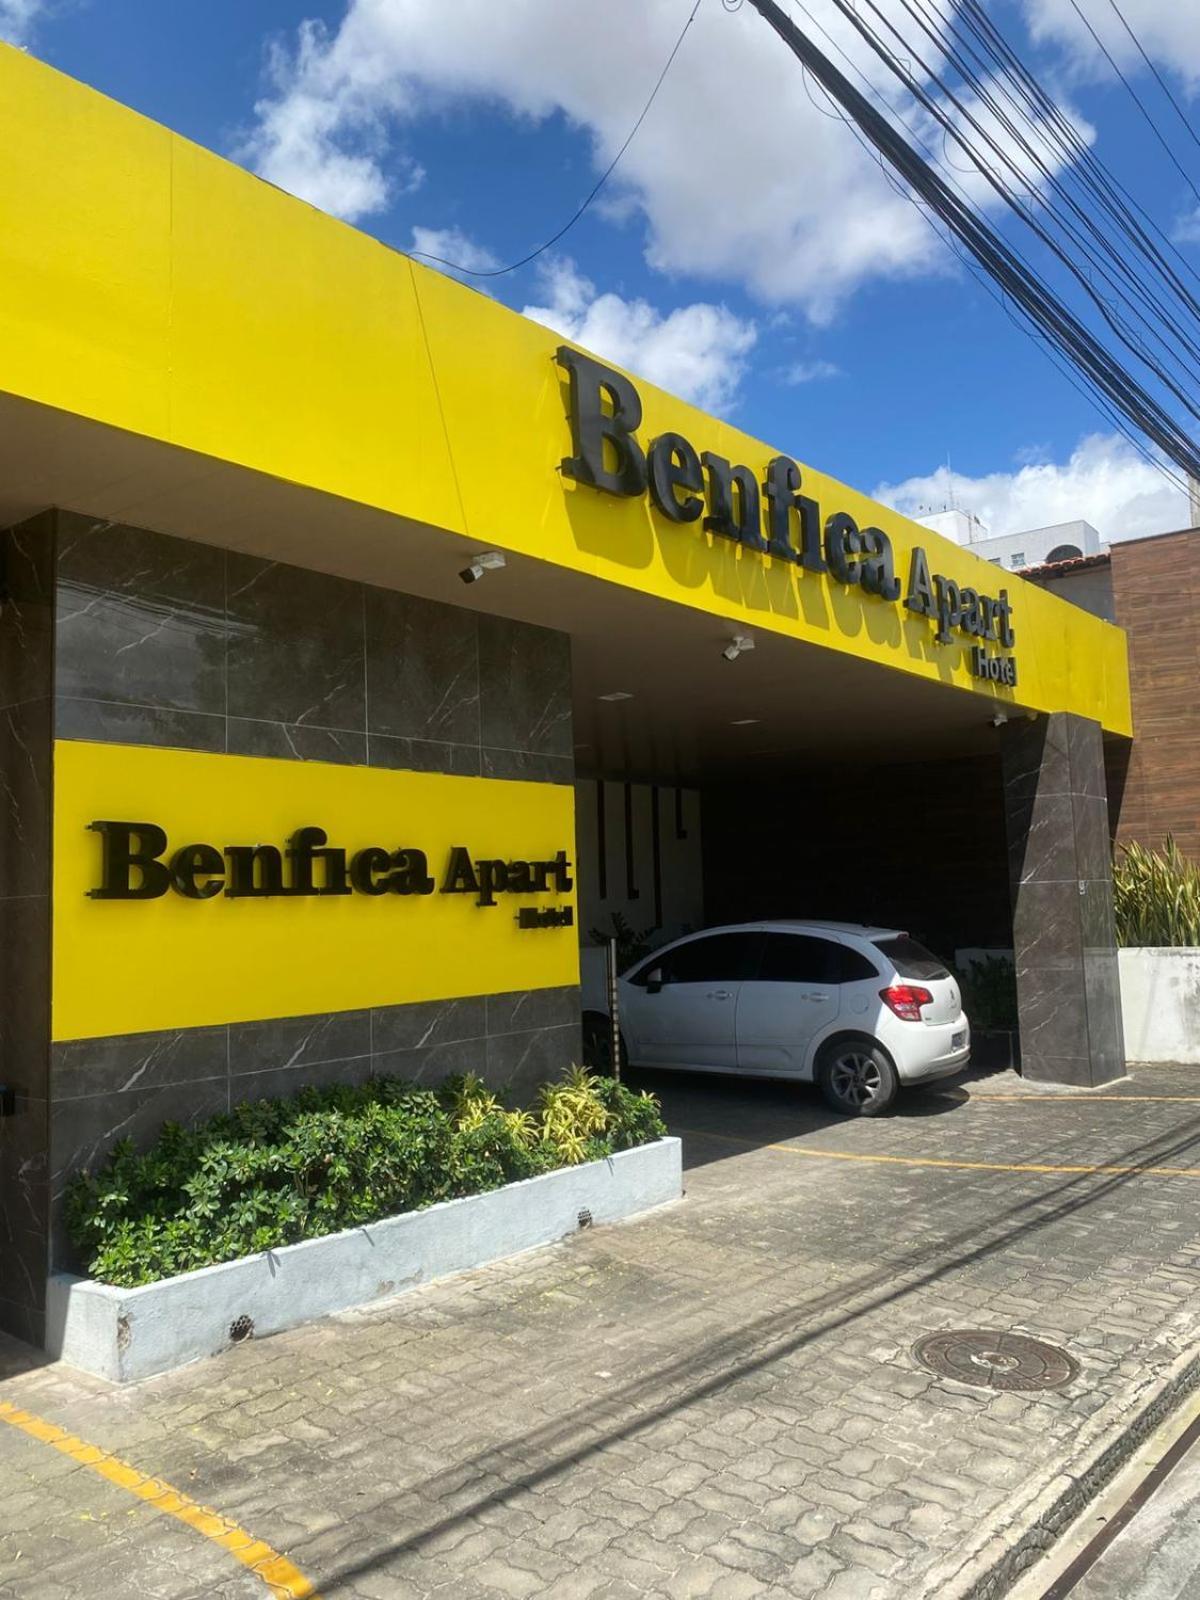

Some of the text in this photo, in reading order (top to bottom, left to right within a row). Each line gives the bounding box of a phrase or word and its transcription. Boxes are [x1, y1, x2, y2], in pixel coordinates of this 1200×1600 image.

[556, 346, 1015, 648] Benfica Apart
[972, 646, 1017, 686] Hotel
[89, 820, 573, 907] Benfica Apart
